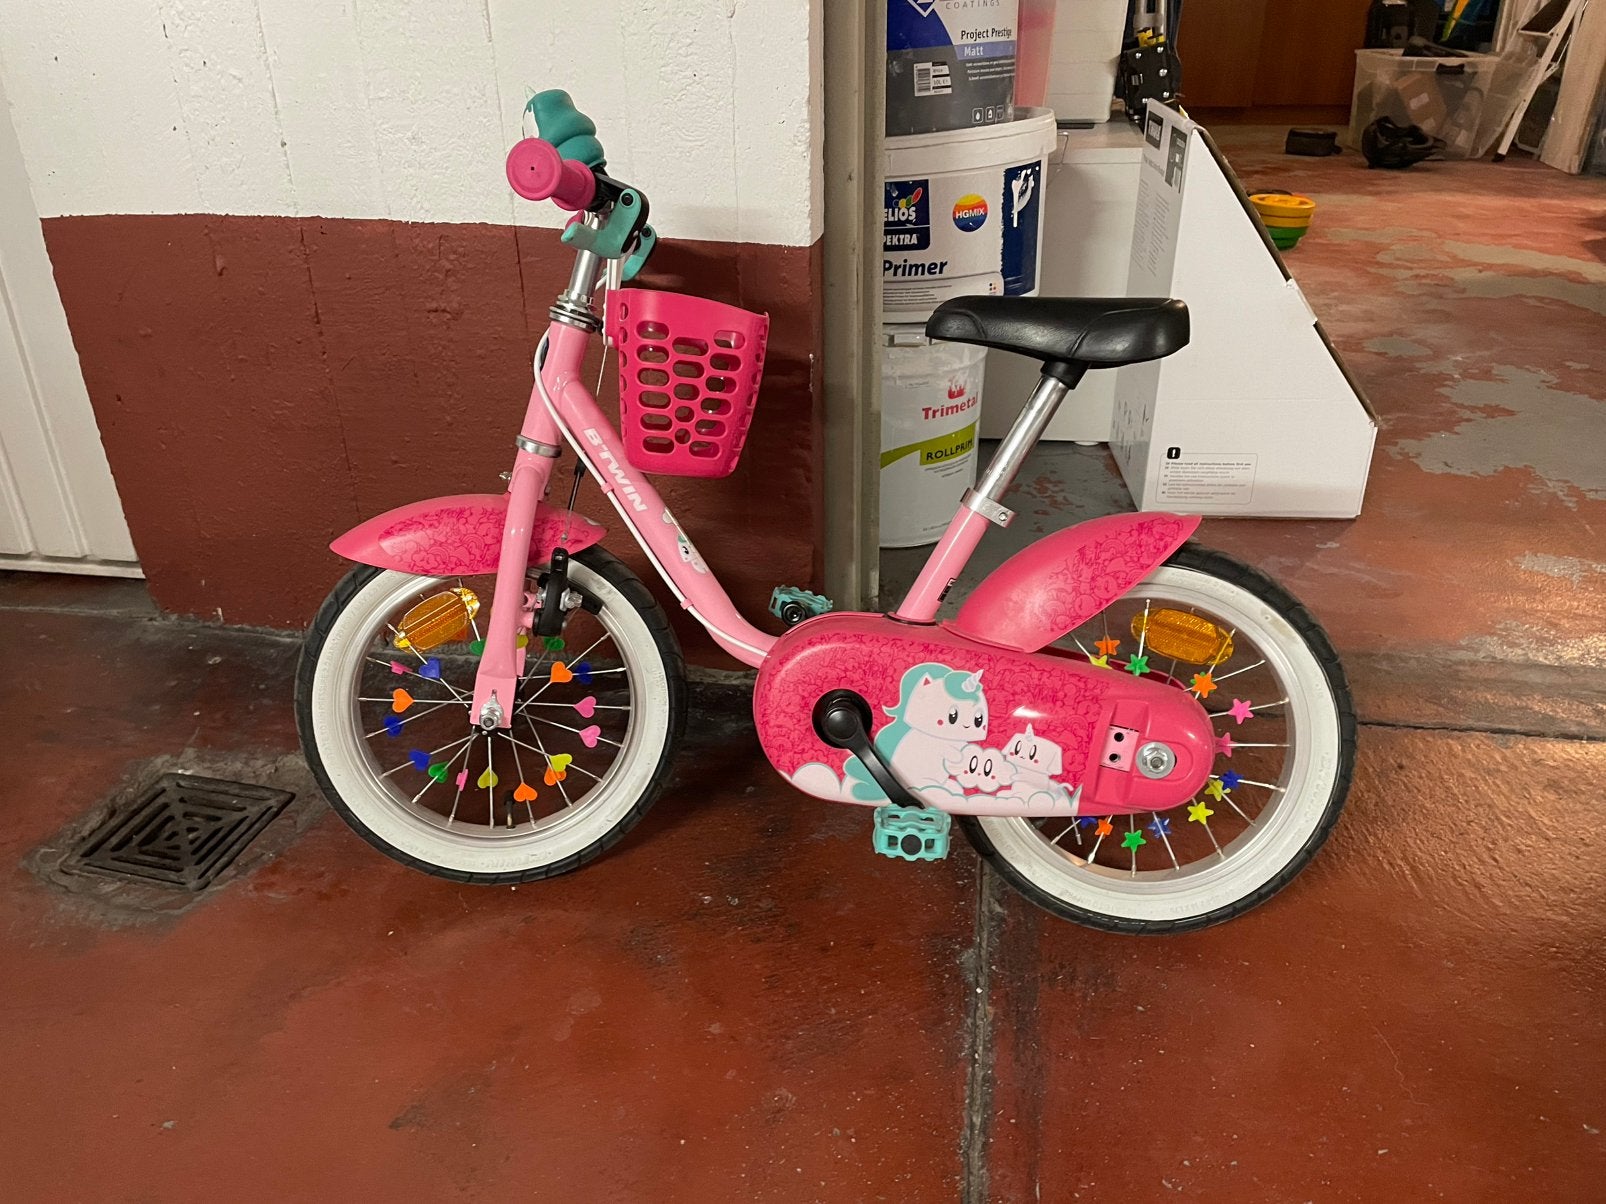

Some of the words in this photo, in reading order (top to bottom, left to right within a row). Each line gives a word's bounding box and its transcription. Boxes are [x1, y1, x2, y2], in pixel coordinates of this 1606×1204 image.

[945, 0, 1000, 9] COATINGS
[960, 28, 989, 41] Project
[964, 46, 984, 56] Matt
[883, 206, 916, 222] ELIOS
[955, 207, 985, 219] HGMIX
[883, 258, 948, 277] Primer
[922, 391, 979, 420] Trimetal
